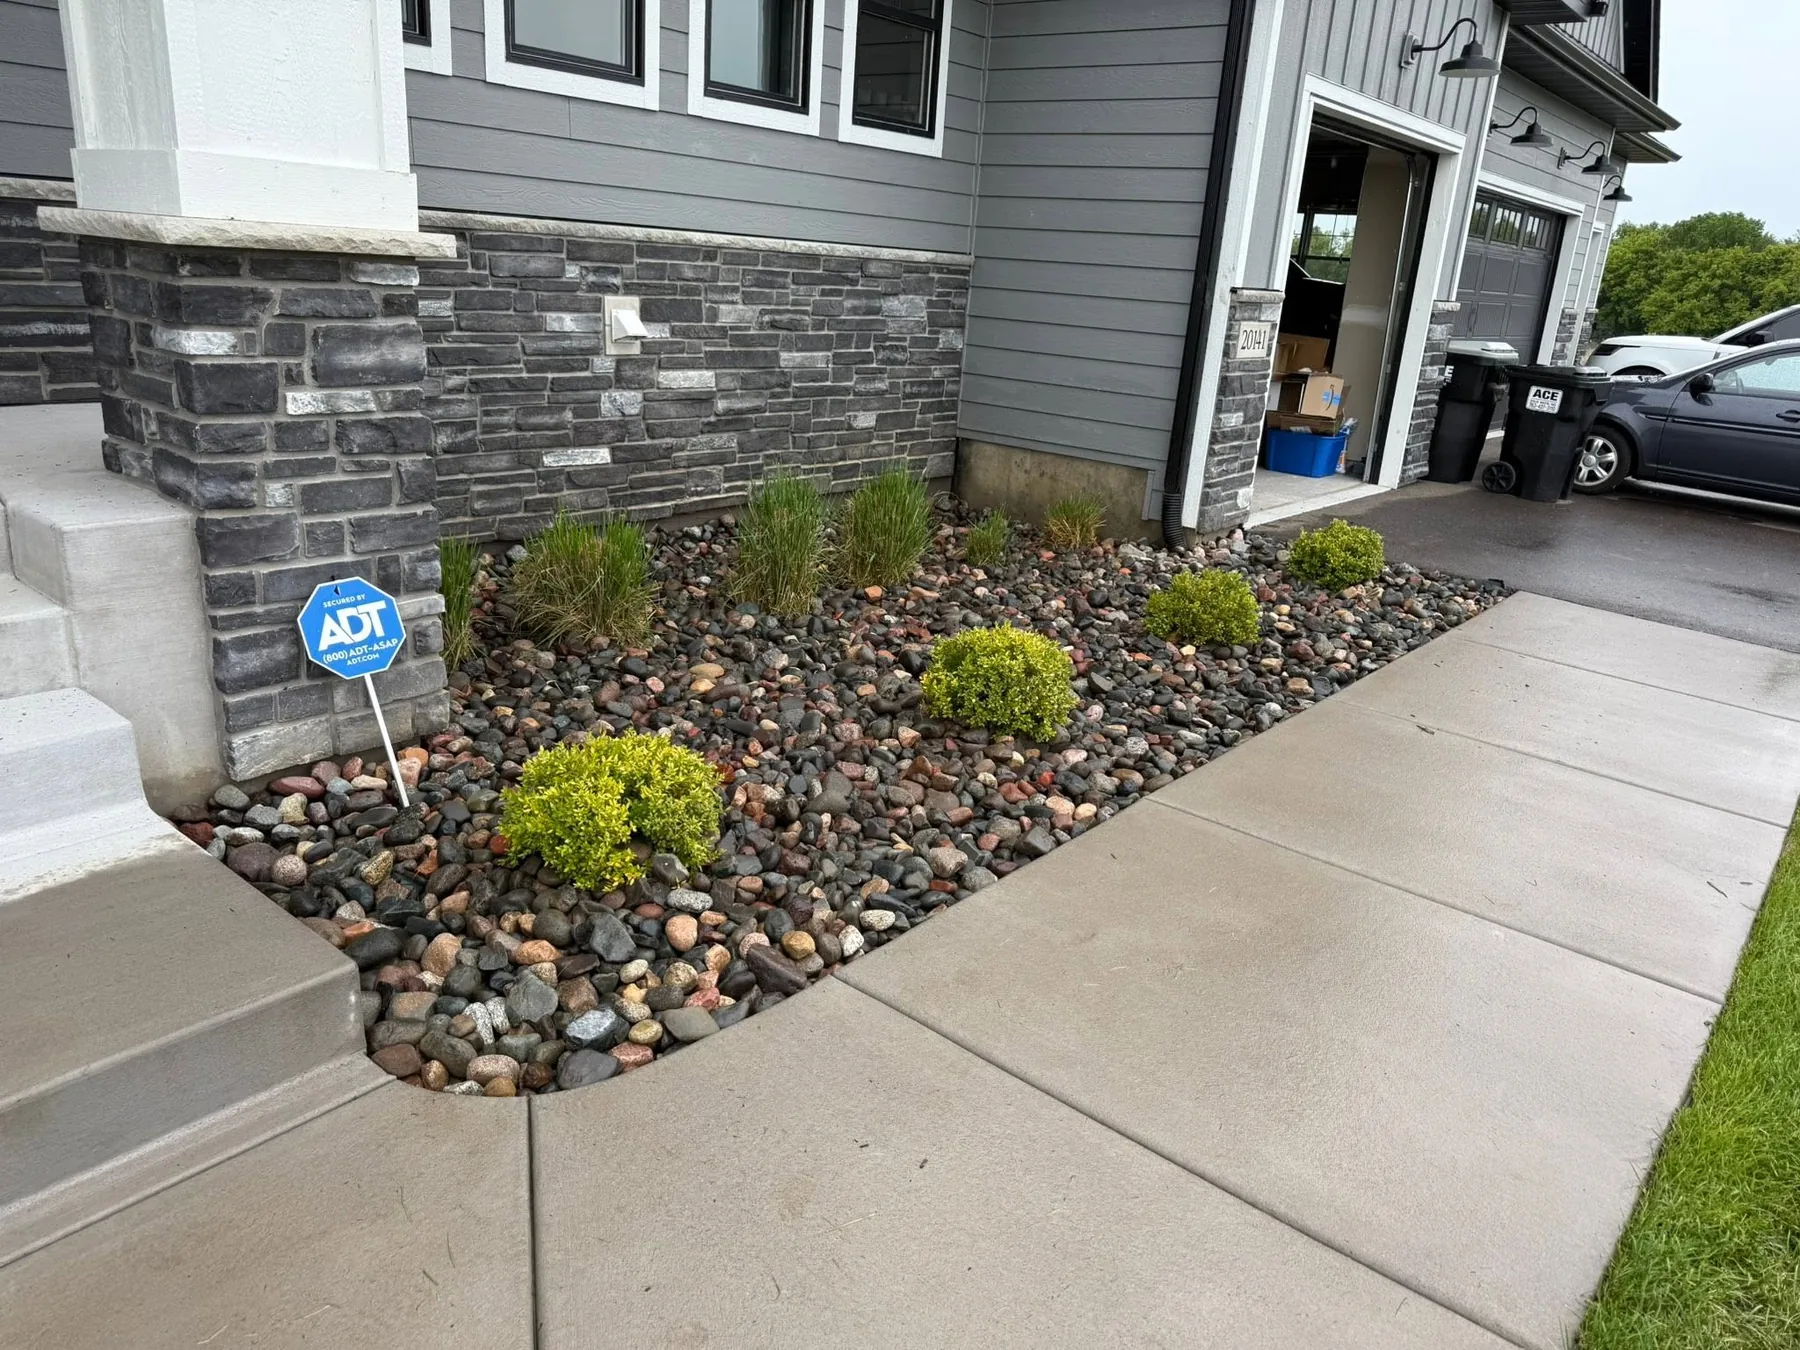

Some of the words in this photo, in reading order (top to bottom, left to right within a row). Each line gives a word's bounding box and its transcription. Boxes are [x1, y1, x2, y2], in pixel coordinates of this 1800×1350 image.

[1241, 329, 1266, 350] 20141
[1533, 389, 1559, 401] ACE
[323, 596, 356, 608] SECURED
[319, 600, 387, 652] ADT
[323, 650, 348, 663] (800)
[349, 638, 398, 656] ADT-ASAP
[347, 652, 380, 666] ADT.COM
